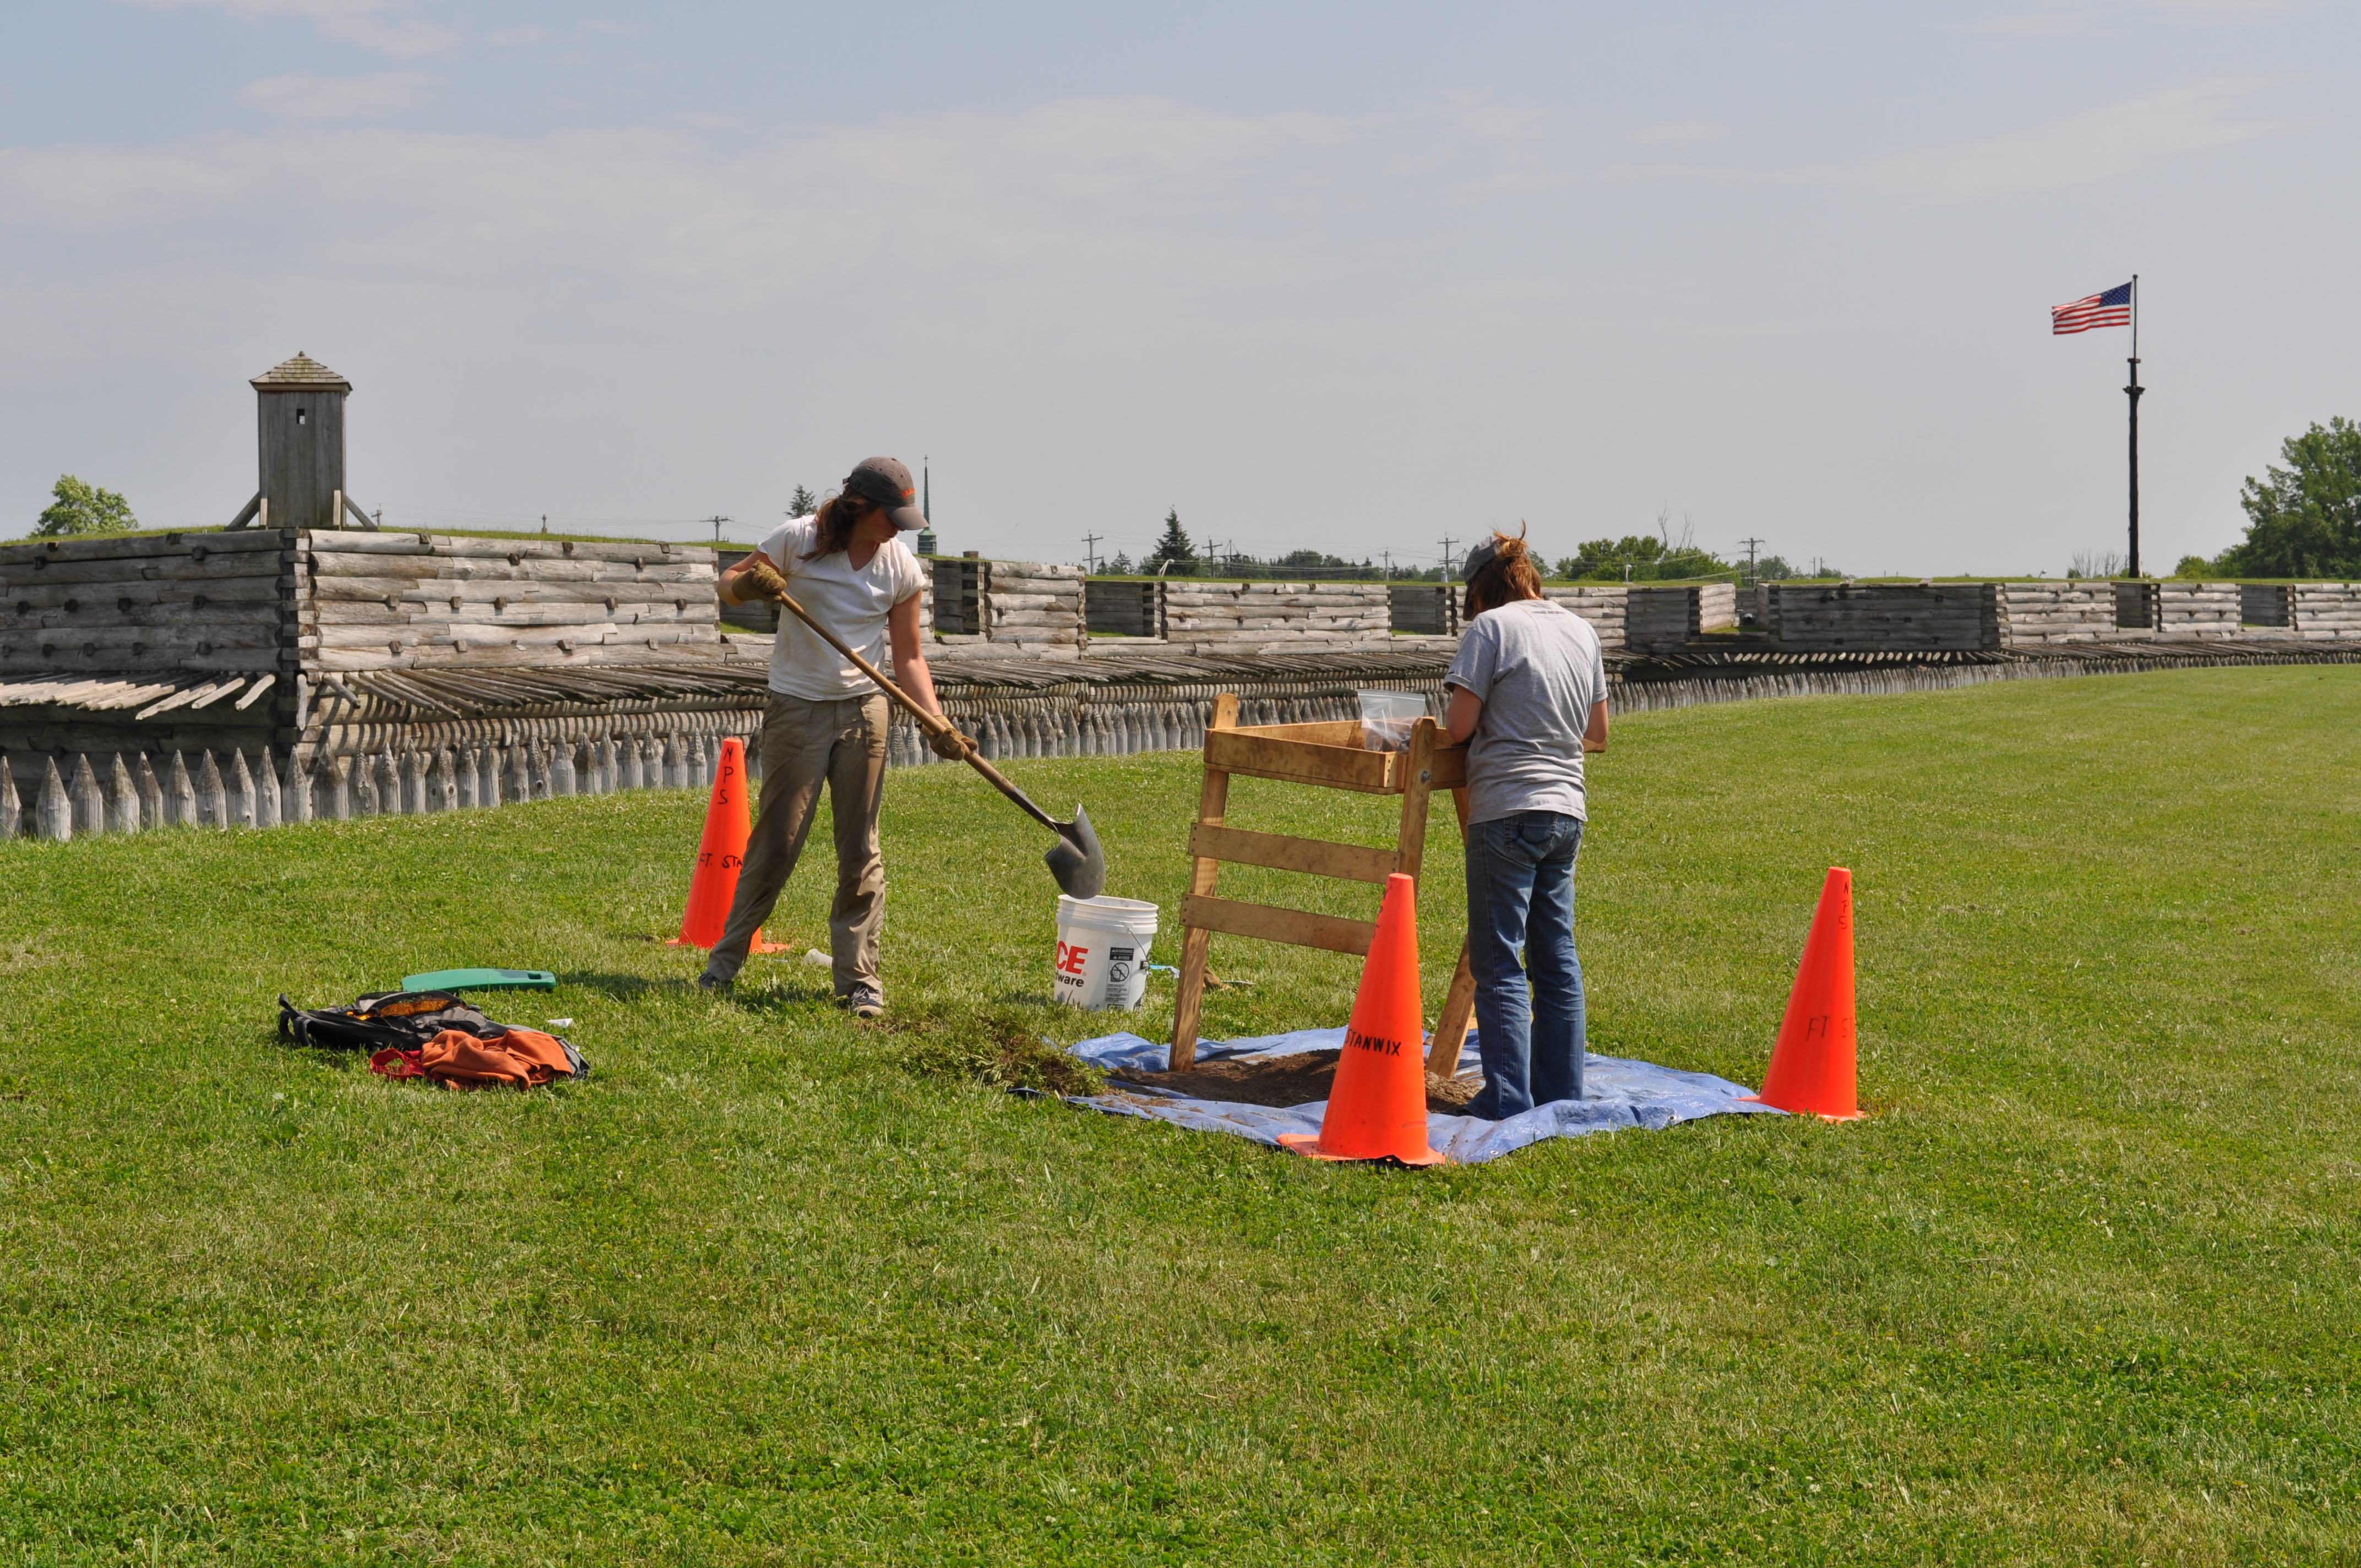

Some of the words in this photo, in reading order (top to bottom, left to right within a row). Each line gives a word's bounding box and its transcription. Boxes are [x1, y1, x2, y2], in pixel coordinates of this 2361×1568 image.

[717, 747, 734, 804] NPS
[1839, 880, 1849, 929] NPS
[1345, 1028, 1401, 1057] STANWIX
[1806, 1016, 1831, 1041] FT
